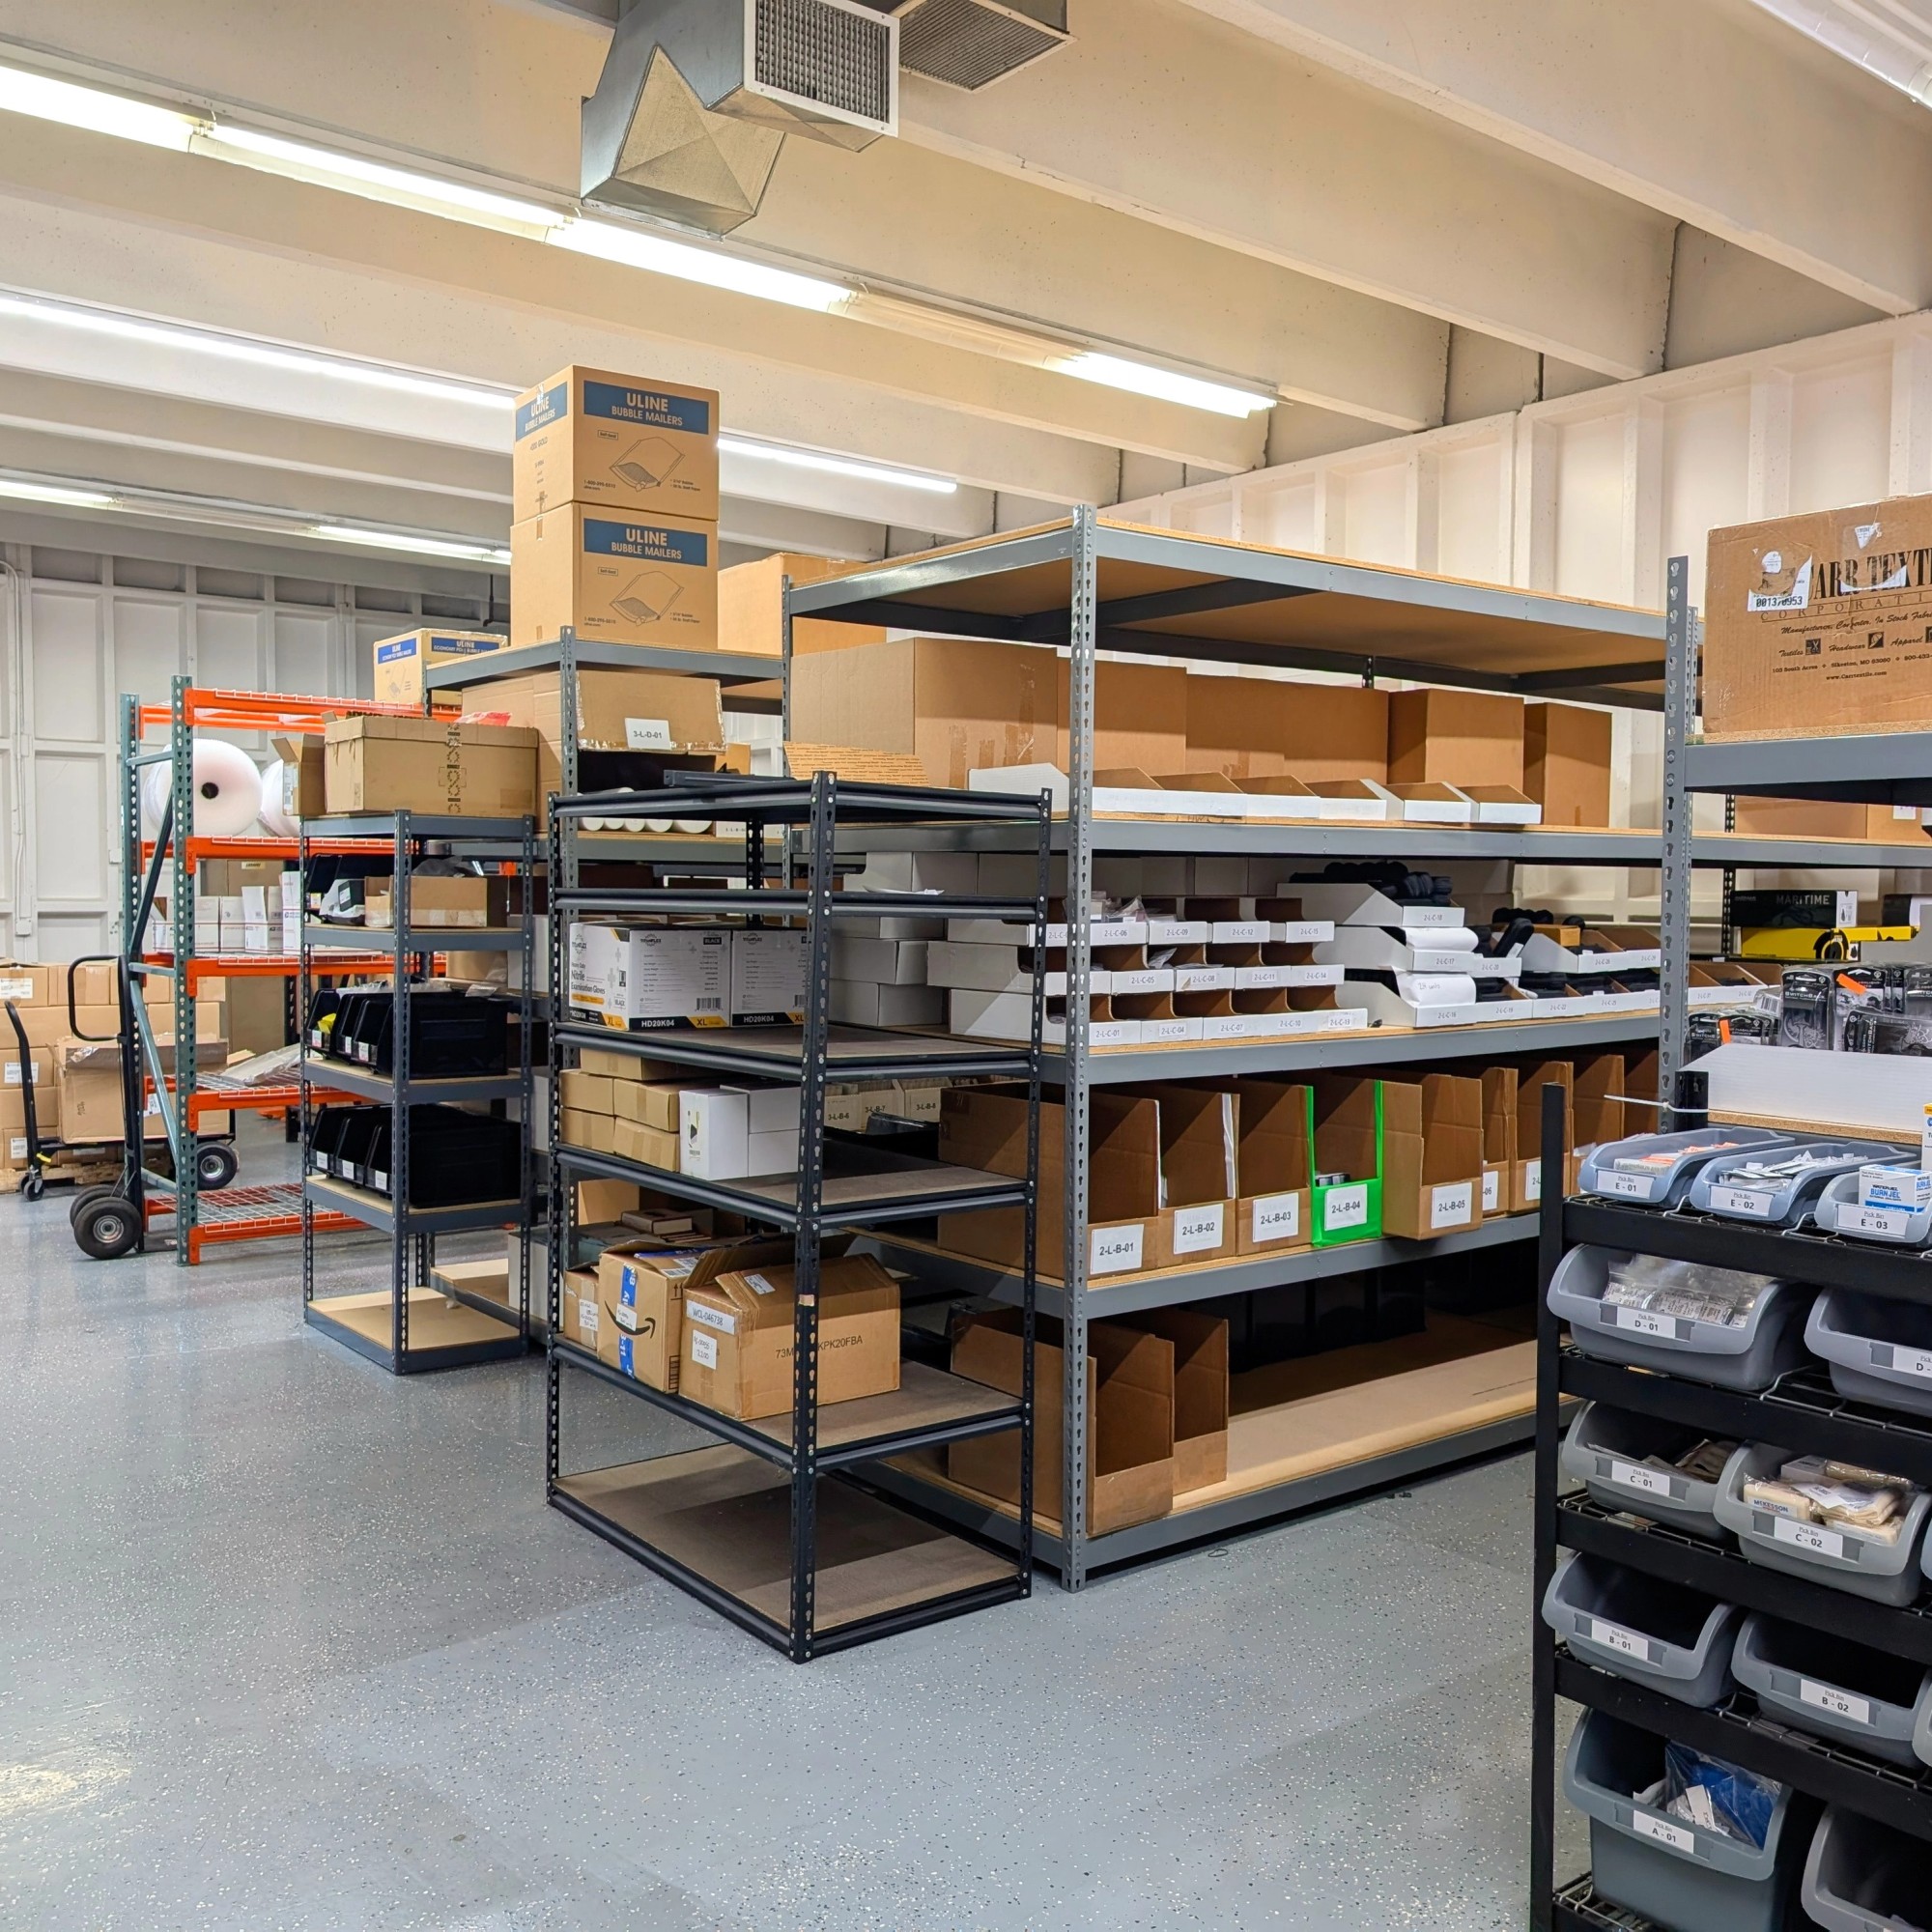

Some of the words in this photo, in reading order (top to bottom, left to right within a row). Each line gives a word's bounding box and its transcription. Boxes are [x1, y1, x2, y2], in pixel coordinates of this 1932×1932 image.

[626, 392, 668, 412] ULINE
[611, 406, 642, 420] BUBBLE
[645, 412, 683, 426] MAILERS
[626, 528, 668, 547] ULINE
[611, 542, 642, 555] BUBBLE
[644, 546, 682, 559] MAILERS
[1866, 548, 1932, 593] TEXT
[1761, 592, 1922, 620] CORPORATI
[1887, 613, 1909, 623] Stock
[1911, 611, 1932, 620] Fabri
[1829, 643, 1865, 652] Headwear
[1890, 636, 1923, 646] Apparel
[633, 730, 662, 739] 3-L-D-01
[1776, 895, 1831, 905] MARITIME
[1048, 931, 1067, 940] 2-L-C-
[571, 970, 585, 981] Nitrile
[1192, 975, 1215, 983] 2-L-C-08
[571, 982, 593, 992] Examination
[592, 985, 606, 995] Gloves
[640, 1019, 675, 1028] HD20K04
[1870, 1187, 1888, 1197] BURN
[1331, 1201, 1361, 1214] 2-L-B-04
[1438, 1199, 1465, 1212] 2-L-B-05
[1744, 1202, 1755, 1210] 02
[1261, 1211, 1292, 1225] 2-L-B-03
[1861, 1218, 1866, 1227] E
[1876, 1220, 1889, 1230] 03
[1181, 1222, 1215, 1236] 2-L-B-02
[1099, 1242, 1134, 1256] 2-L-B-01
[1634, 1320, 1641, 1328] D
[1648, 1322, 1659, 1331] 01
[1916, 1362, 1924, 1372] D
[1643, 1478, 1653, 1488] 01
[1795, 1533, 1803, 1543] C
[1810, 1538, 1823, 1548] 02
[1608, 1635, 1615, 1644] B
[1622, 1640, 1632, 1651] 01
[1822, 1696, 1829, 1705] B
[1837, 1702, 1849, 1713] 02
[1652, 1828, 1659, 1836] A
[1666, 1833, 1677, 1843] 01
